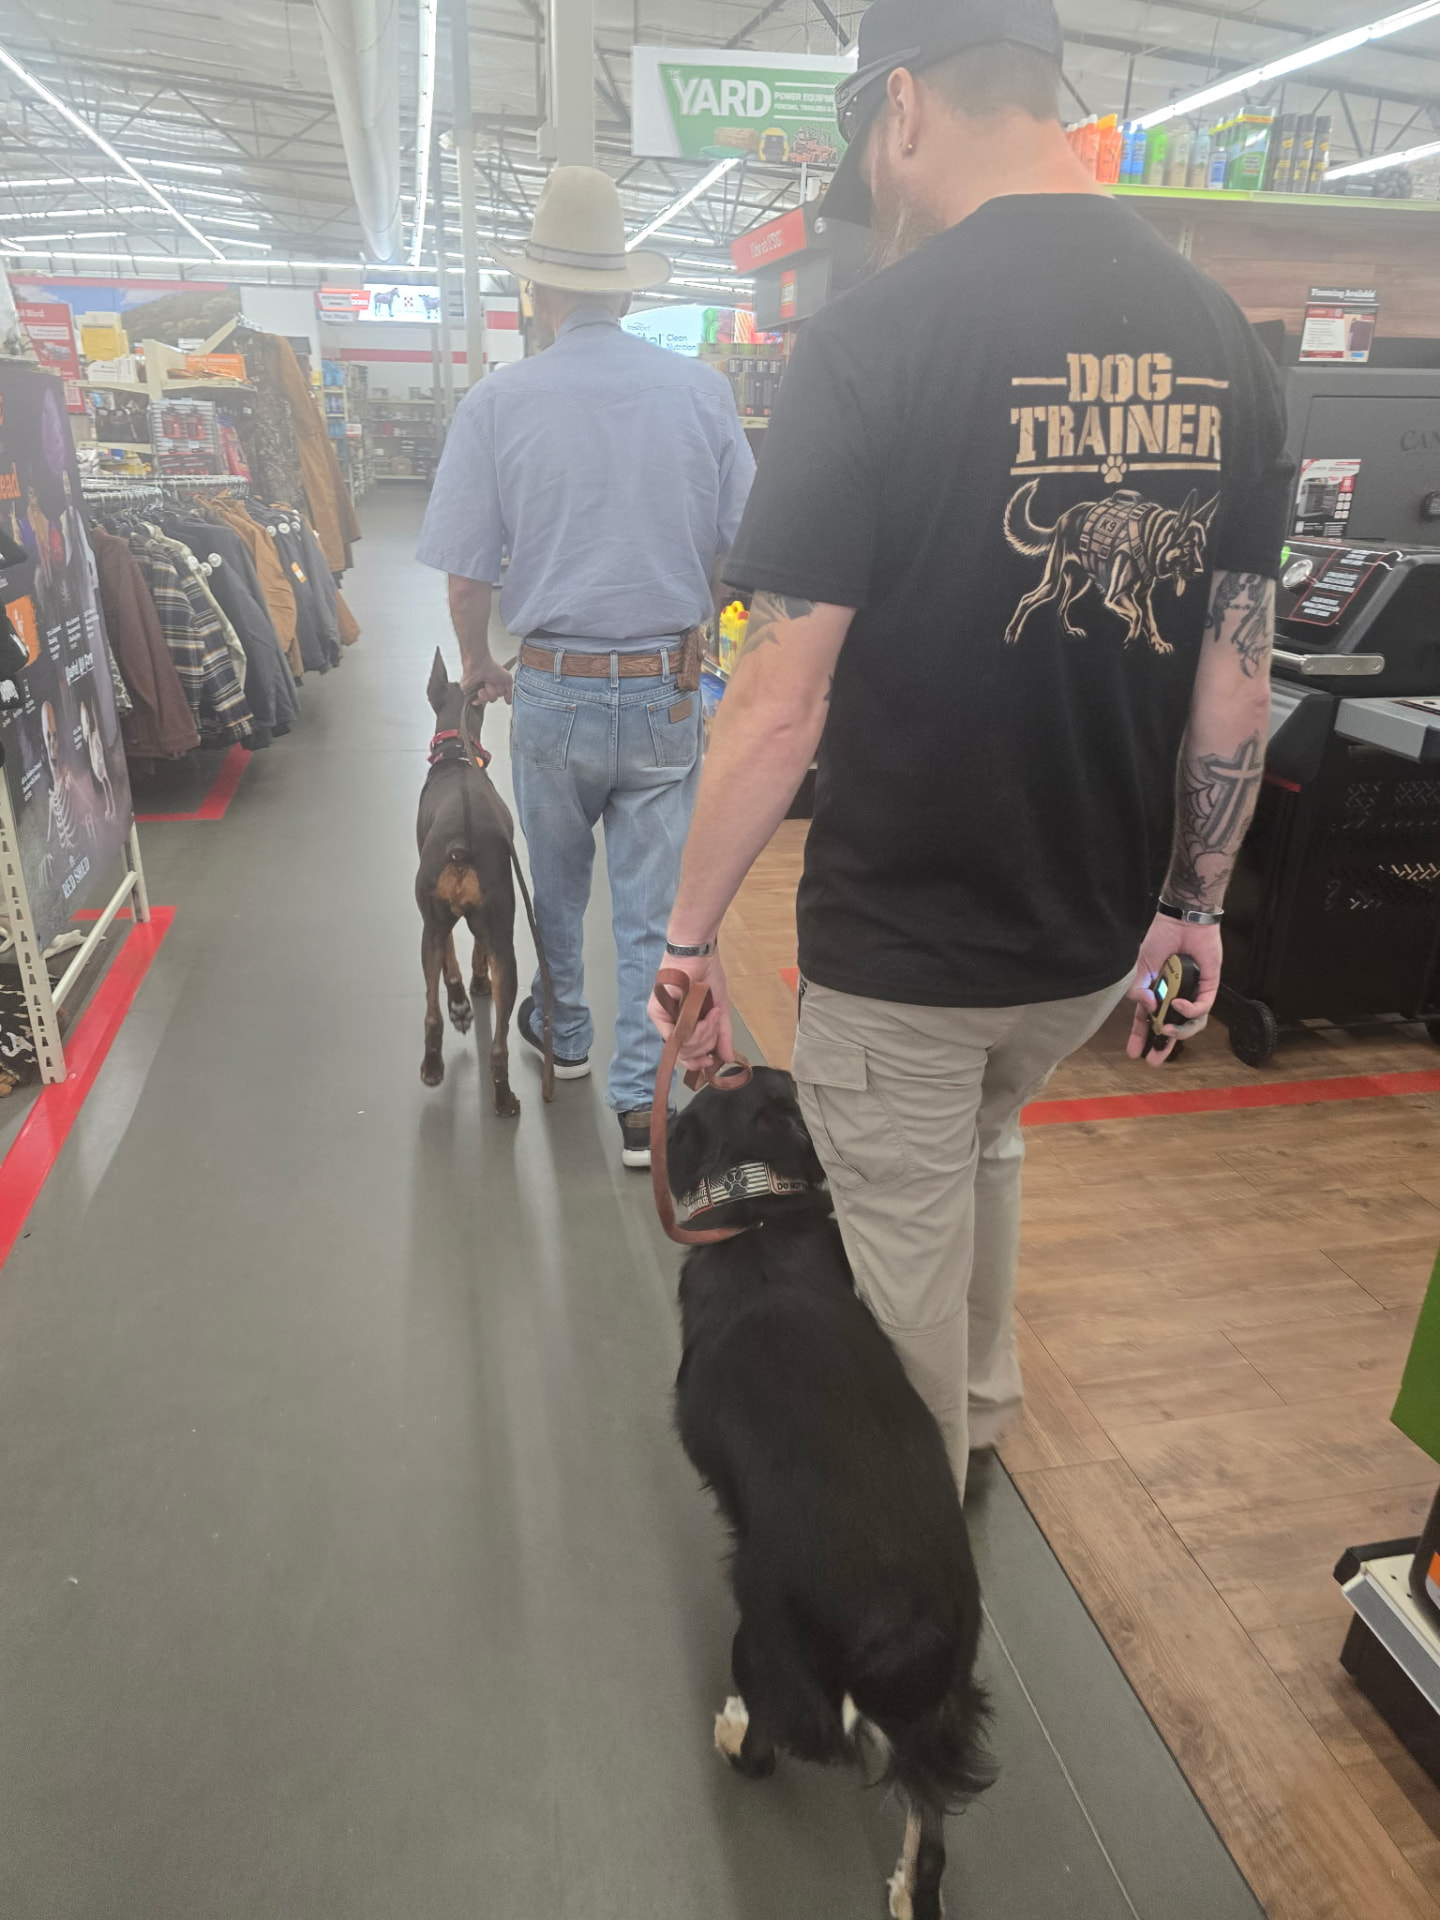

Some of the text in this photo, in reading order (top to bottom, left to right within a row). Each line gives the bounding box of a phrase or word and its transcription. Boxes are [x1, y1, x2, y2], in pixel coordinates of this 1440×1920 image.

[672, 79, 772, 117] YARD
[774, 91, 801, 101] POWER
[667, 333, 688, 342] Clean
[1066, 352, 1172, 402] DOG
[1010, 404, 1222, 464] TRAINER
[1100, 519, 1117, 533] K9
[62, 857, 90, 898] RED SHED
[777, 1182, 789, 1190] DO
